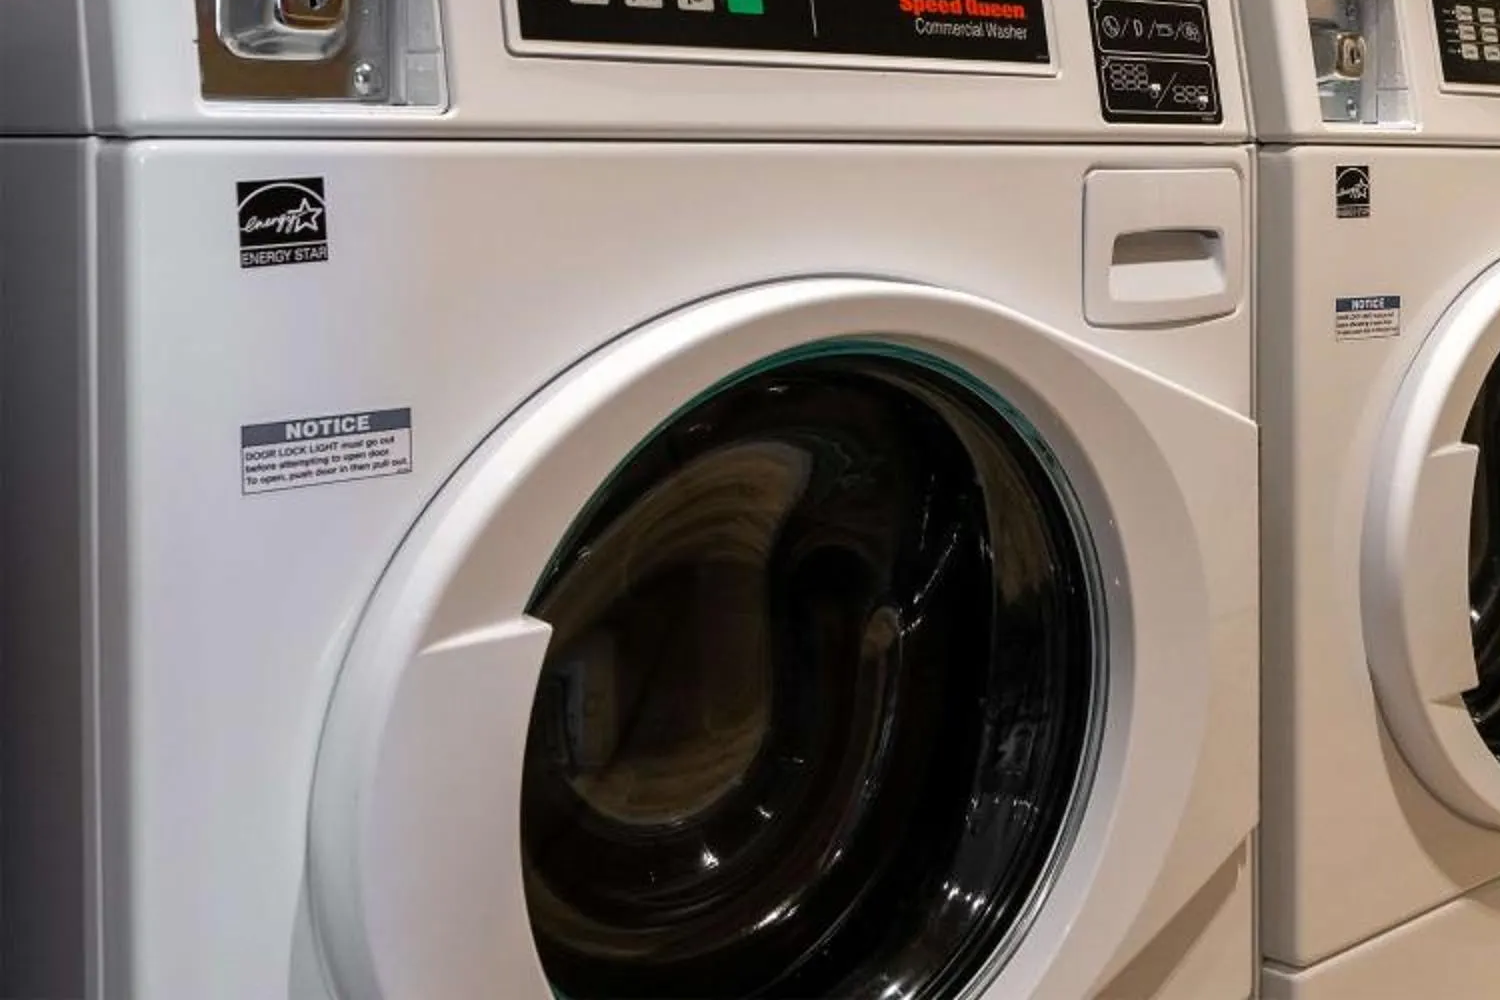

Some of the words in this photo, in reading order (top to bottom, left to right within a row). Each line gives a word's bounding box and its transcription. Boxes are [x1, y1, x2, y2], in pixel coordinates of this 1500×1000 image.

[914, 17, 984, 38] Commercial
[985, 22, 1028, 40] Washer
[241, 249, 292, 266] ENERGY
[294, 245, 328, 261] STAR
[285, 415, 371, 441] NOTICE
[245, 449, 277, 461] DOOR
[278, 446, 307, 458] LOCK
[309, 442, 339, 454] LIGHT
